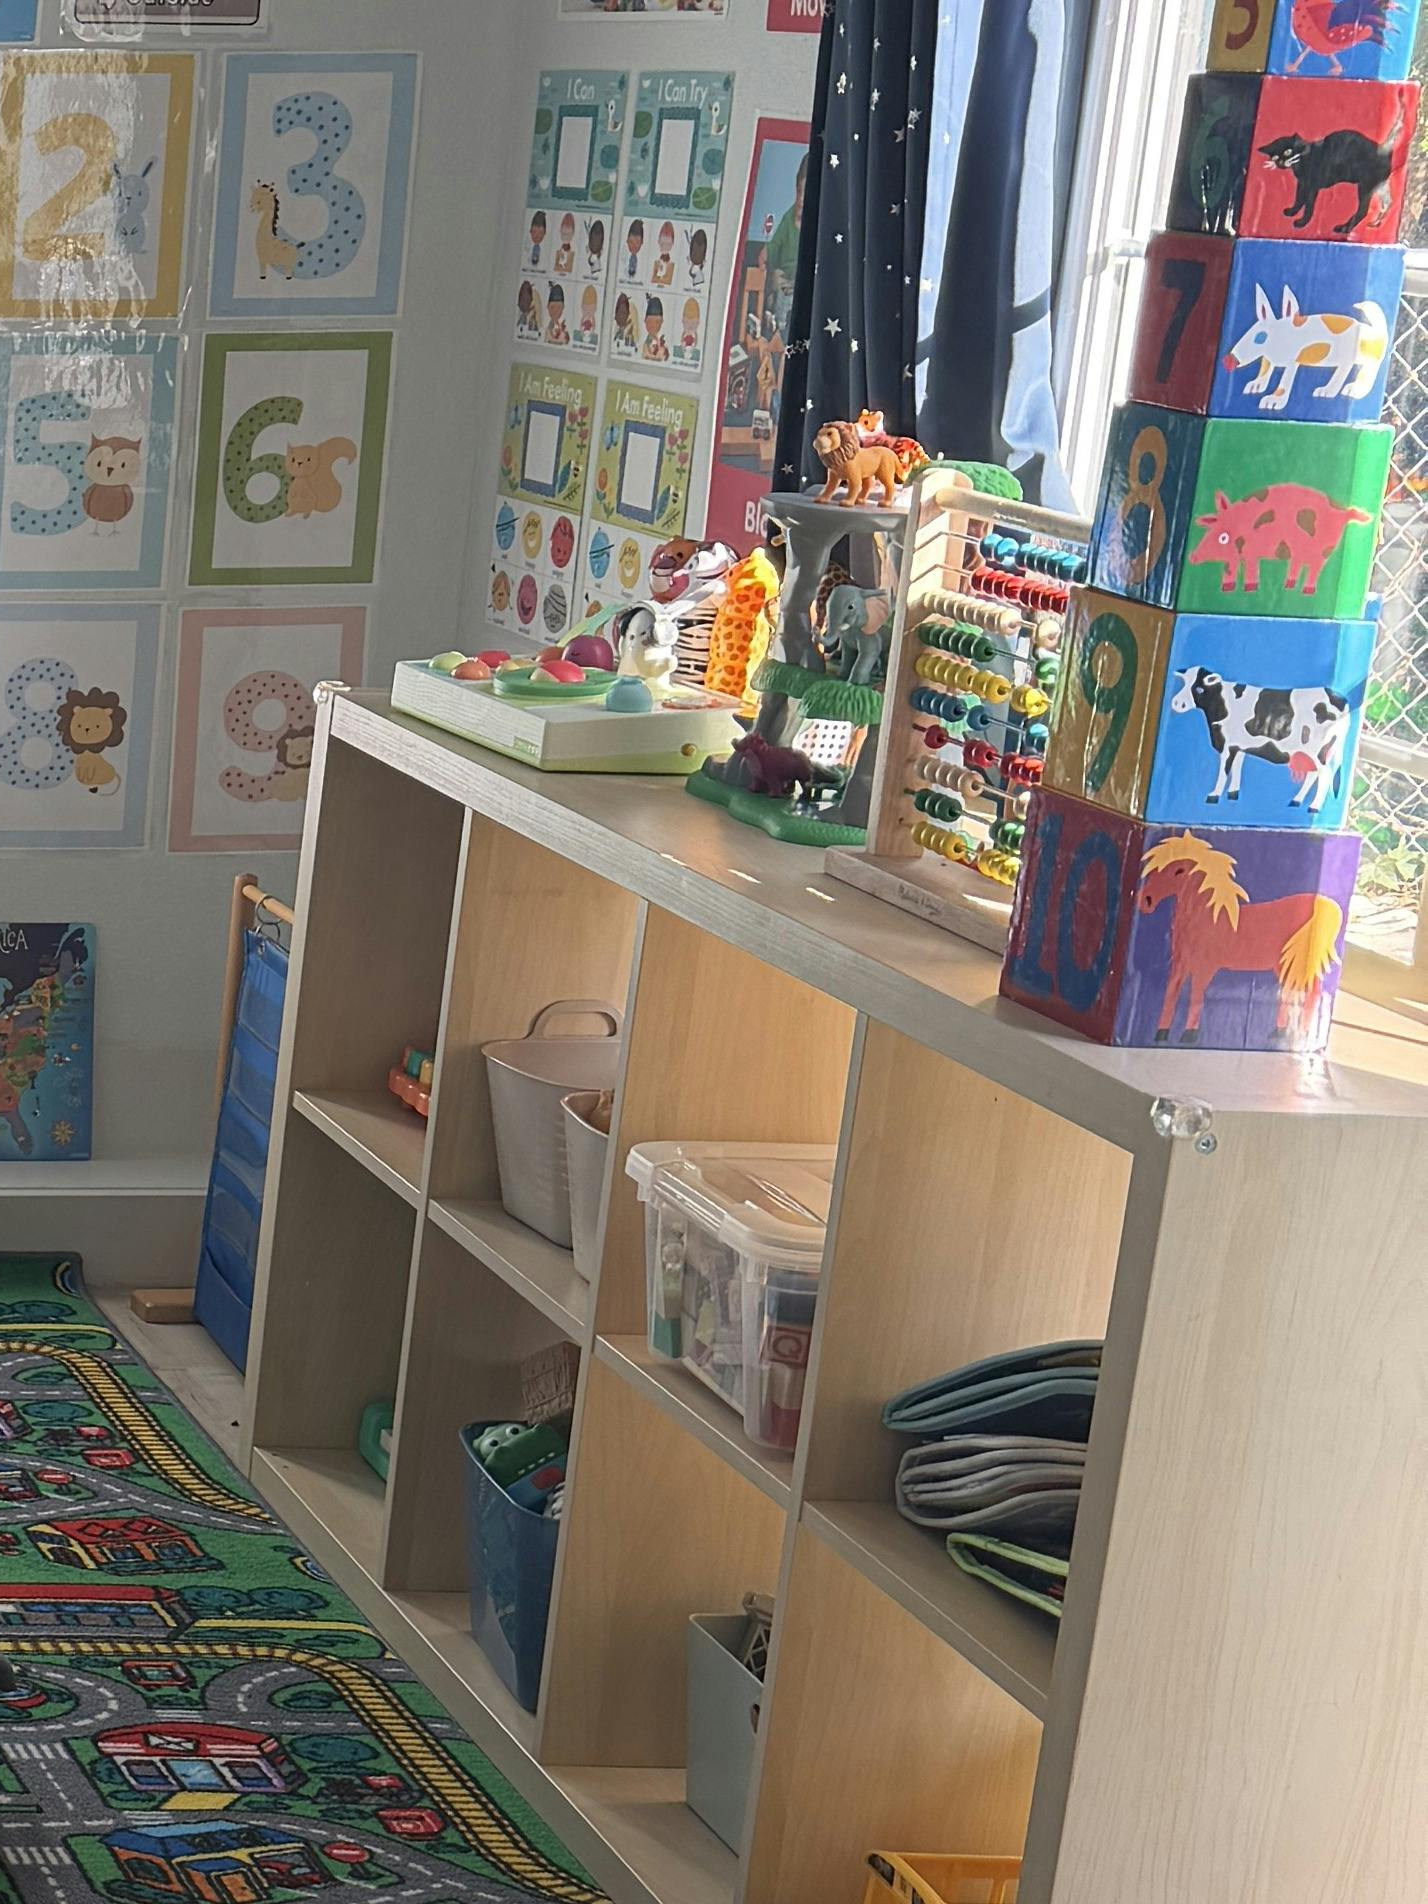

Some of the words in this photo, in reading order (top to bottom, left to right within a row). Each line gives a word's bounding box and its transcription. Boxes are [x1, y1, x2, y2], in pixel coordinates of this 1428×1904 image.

[574, 78, 594, 100] Can
[664, 79, 687, 101] Can
[690, 79, 708, 109] Try
[21, 111, 118, 261] 2
[272, 90, 368, 280] 3
[1153, 259, 1206, 384] 7
[526, 375, 541, 393] Am
[544, 376, 583, 408] Feeling
[621, 394, 640, 415] Am
[643, 396, 683, 430] Feeling
[9, 392, 94, 537] 5
[224, 395, 305, 524] 6
[1120, 424, 1168, 584] 8
[218, 669, 315, 803] 9
[1084, 613, 1139, 792] 9
[1015, 812, 1123, 1011] 10
